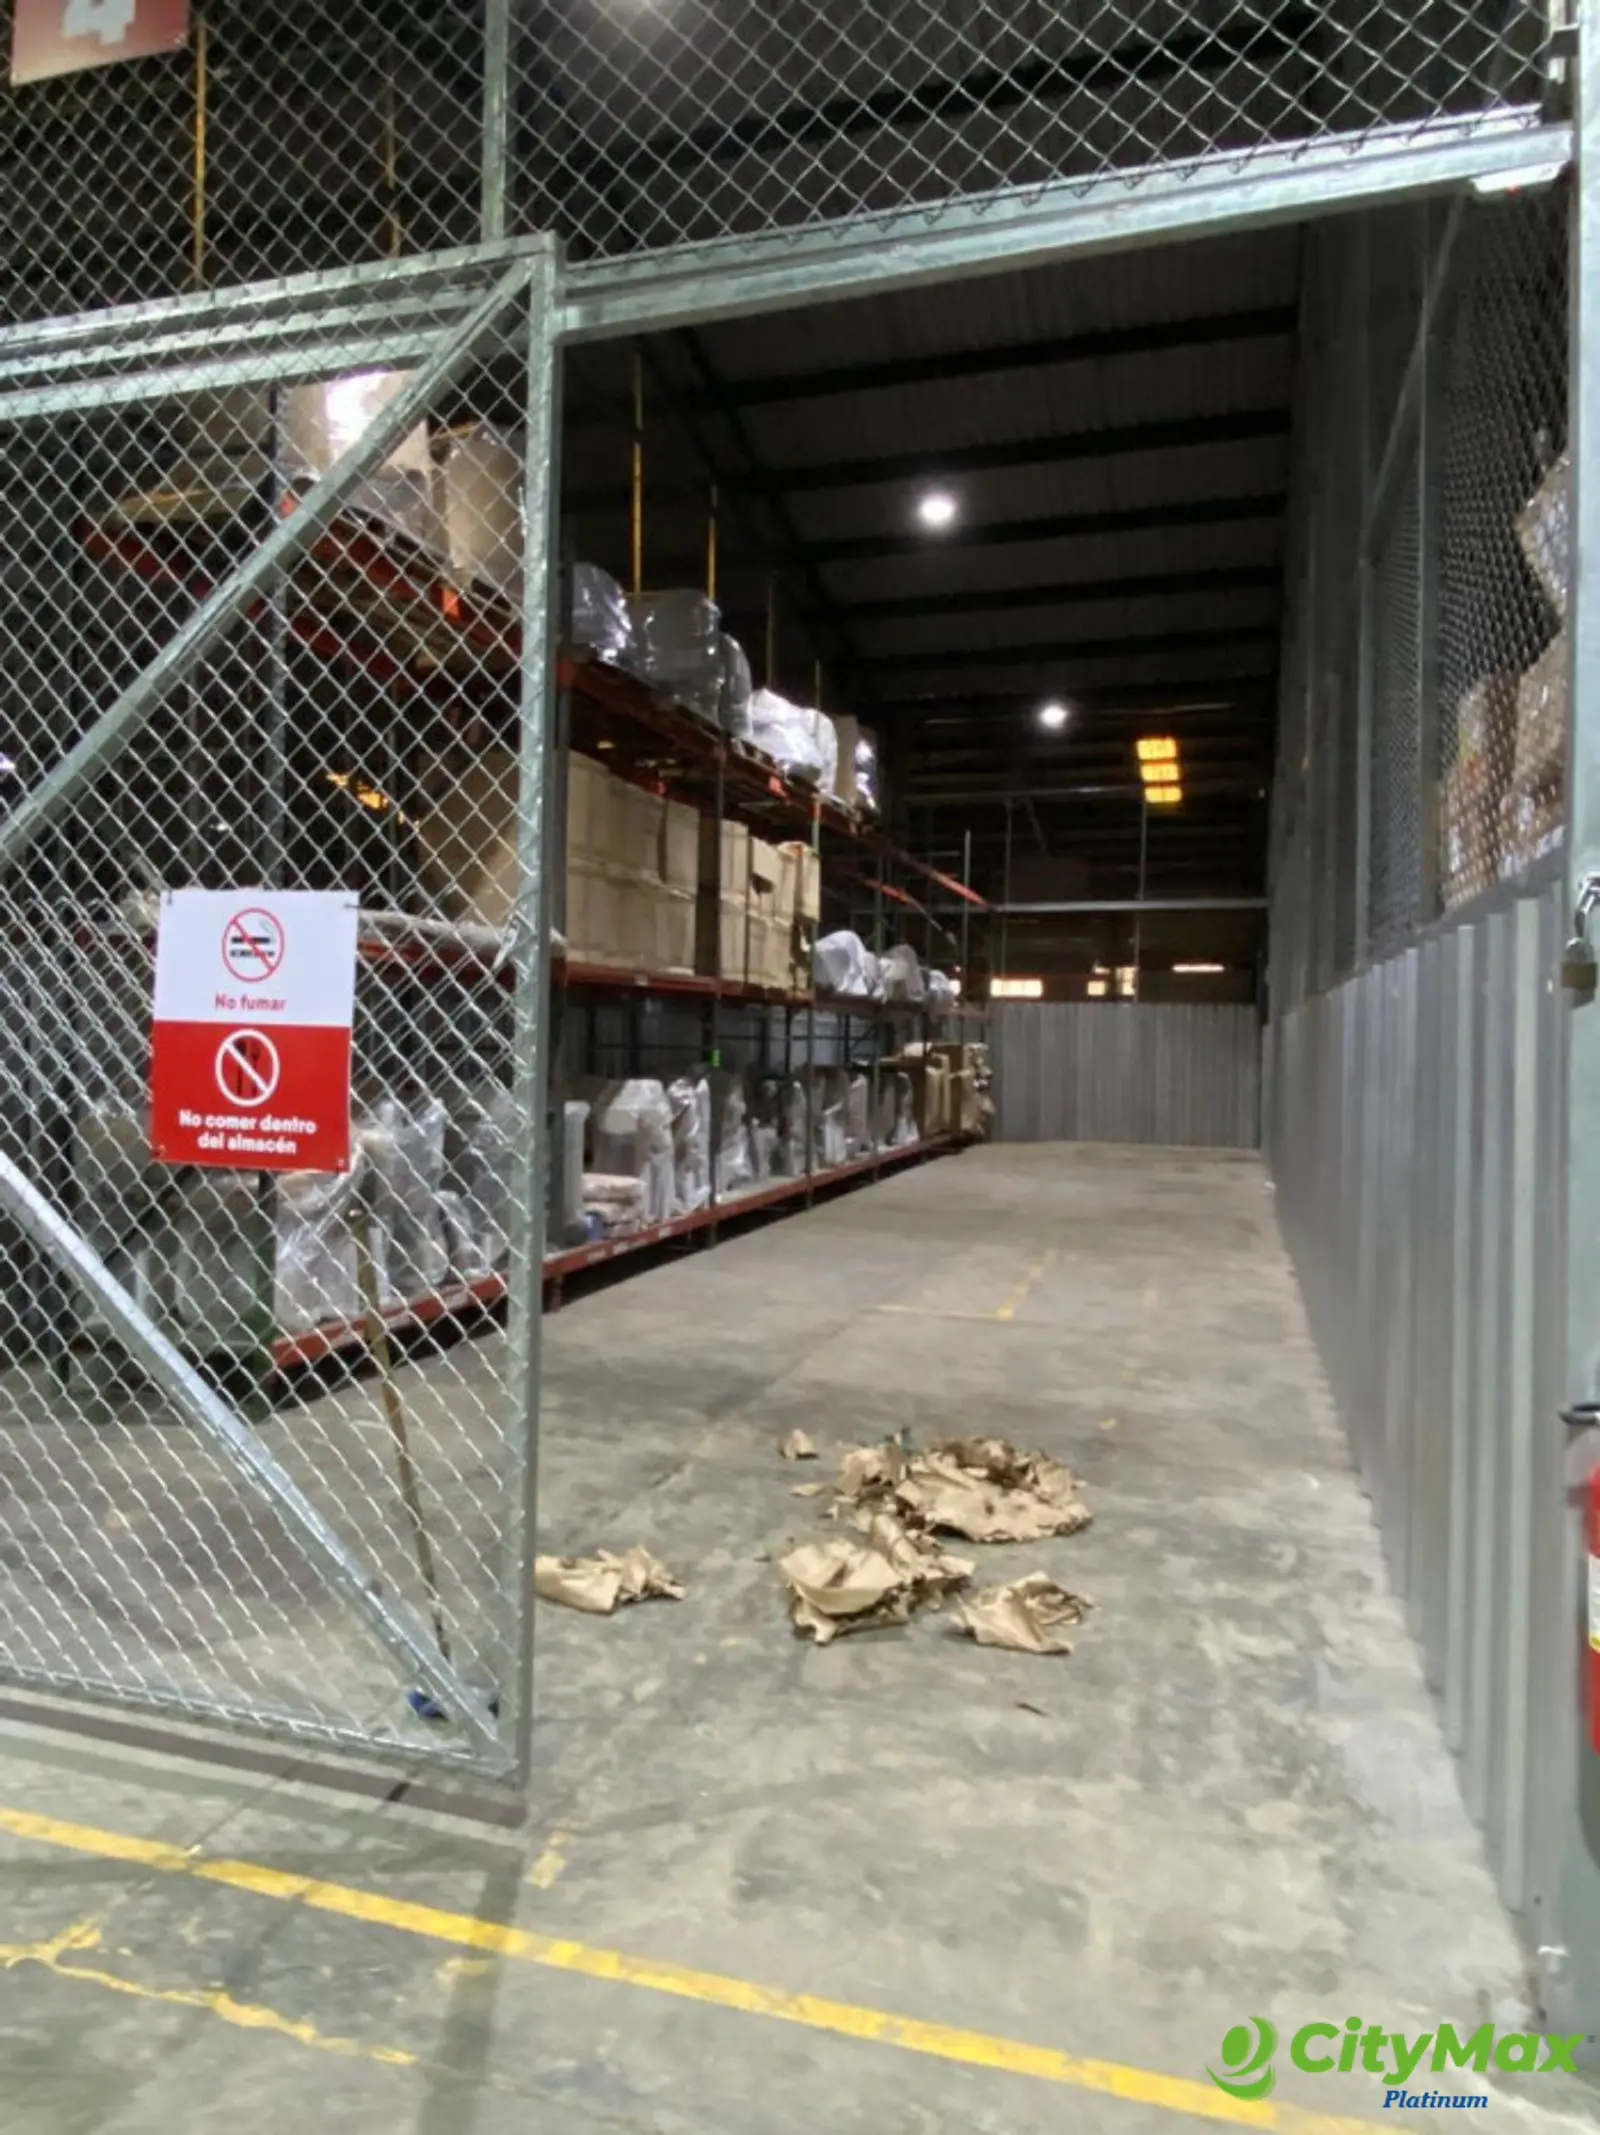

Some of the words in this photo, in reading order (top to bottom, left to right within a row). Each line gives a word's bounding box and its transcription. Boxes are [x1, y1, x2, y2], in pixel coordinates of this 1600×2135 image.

[214, 993, 236, 1010] No
[240, 994, 286, 1011] fumar
[178, 1109, 202, 1128] No
[205, 1114, 256, 1130] comer
[260, 1115, 317, 1134] dentro
[197, 1132, 224, 1149] del
[227, 1133, 297, 1154] almacén
